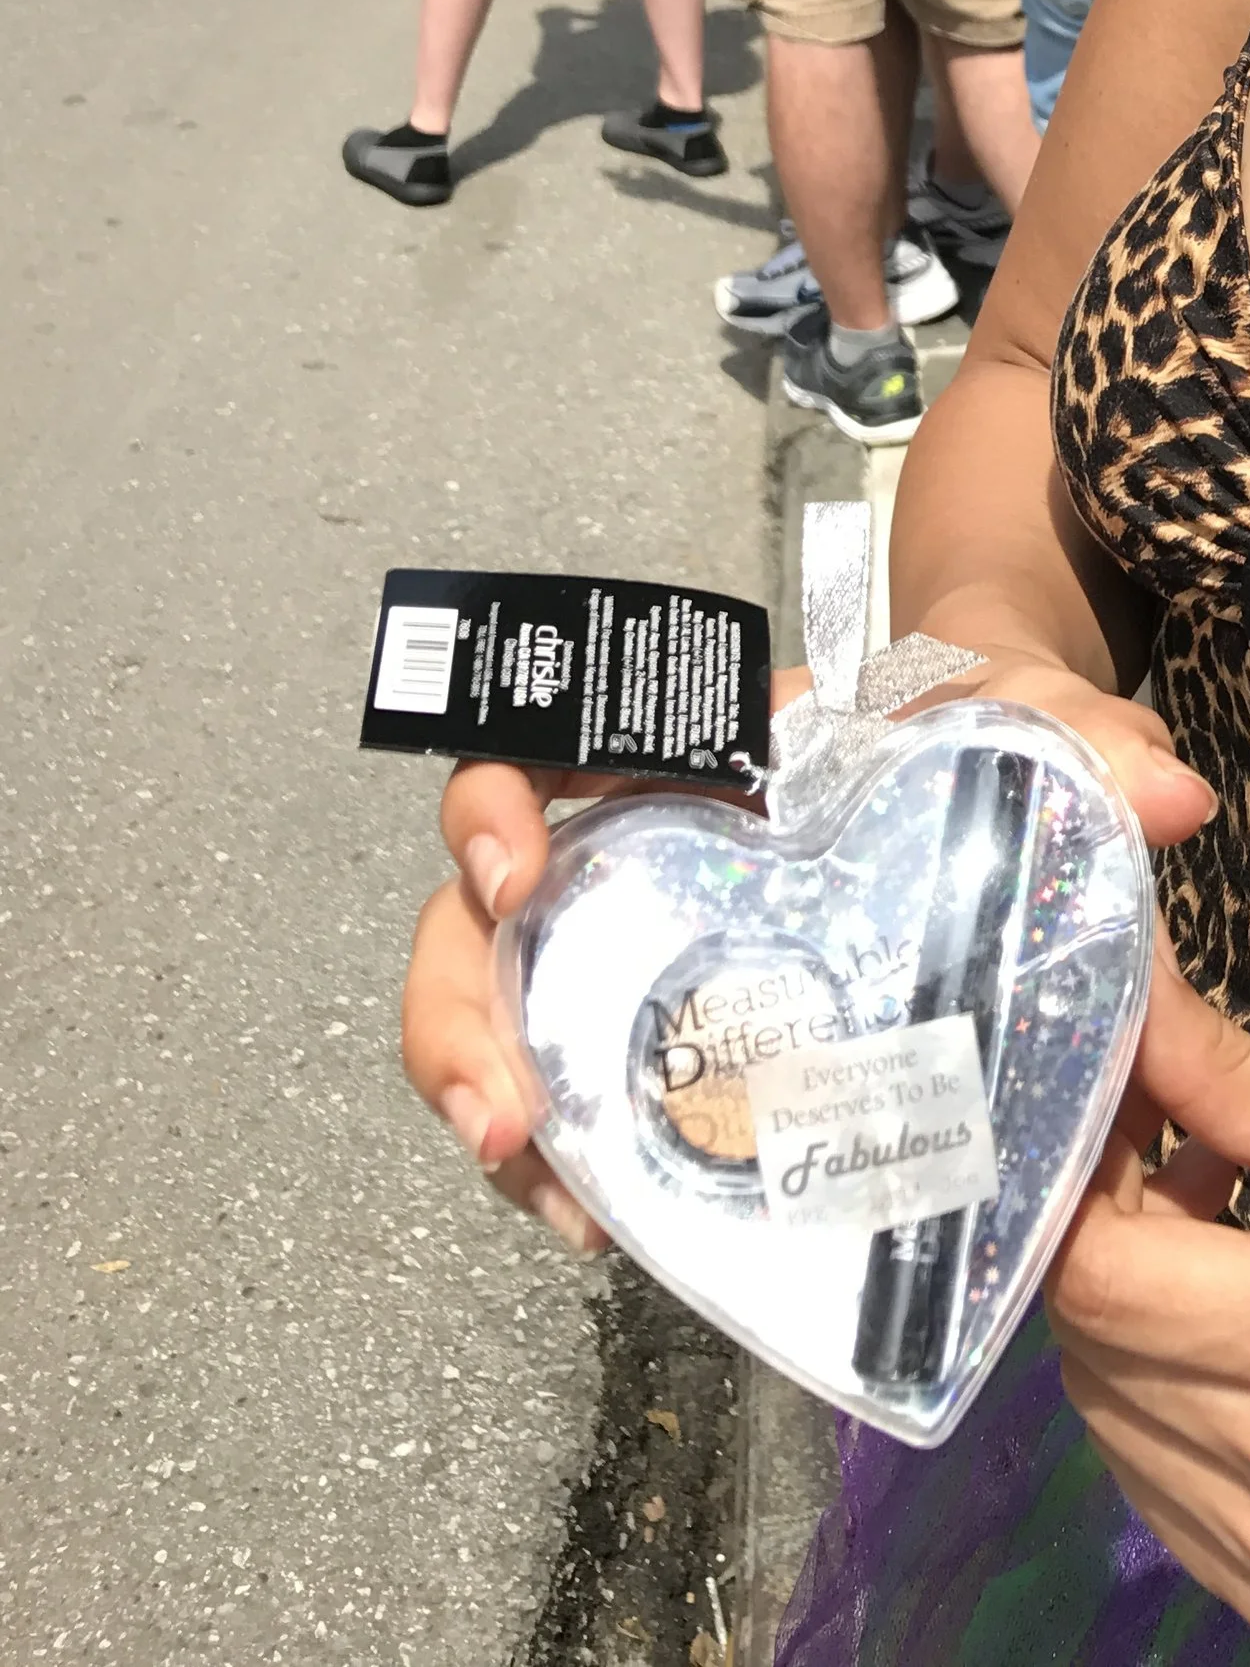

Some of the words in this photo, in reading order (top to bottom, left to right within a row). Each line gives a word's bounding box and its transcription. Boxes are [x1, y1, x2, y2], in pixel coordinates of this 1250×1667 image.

[655, 995, 914, 1092] Differenc
[802, 1047, 919, 1092] Everyone
[771, 1092, 886, 1134] Deserves
[888, 1081, 924, 1107] To
[931, 1072, 960, 1099] Be
[781, 1120, 972, 1197] Fabulous
